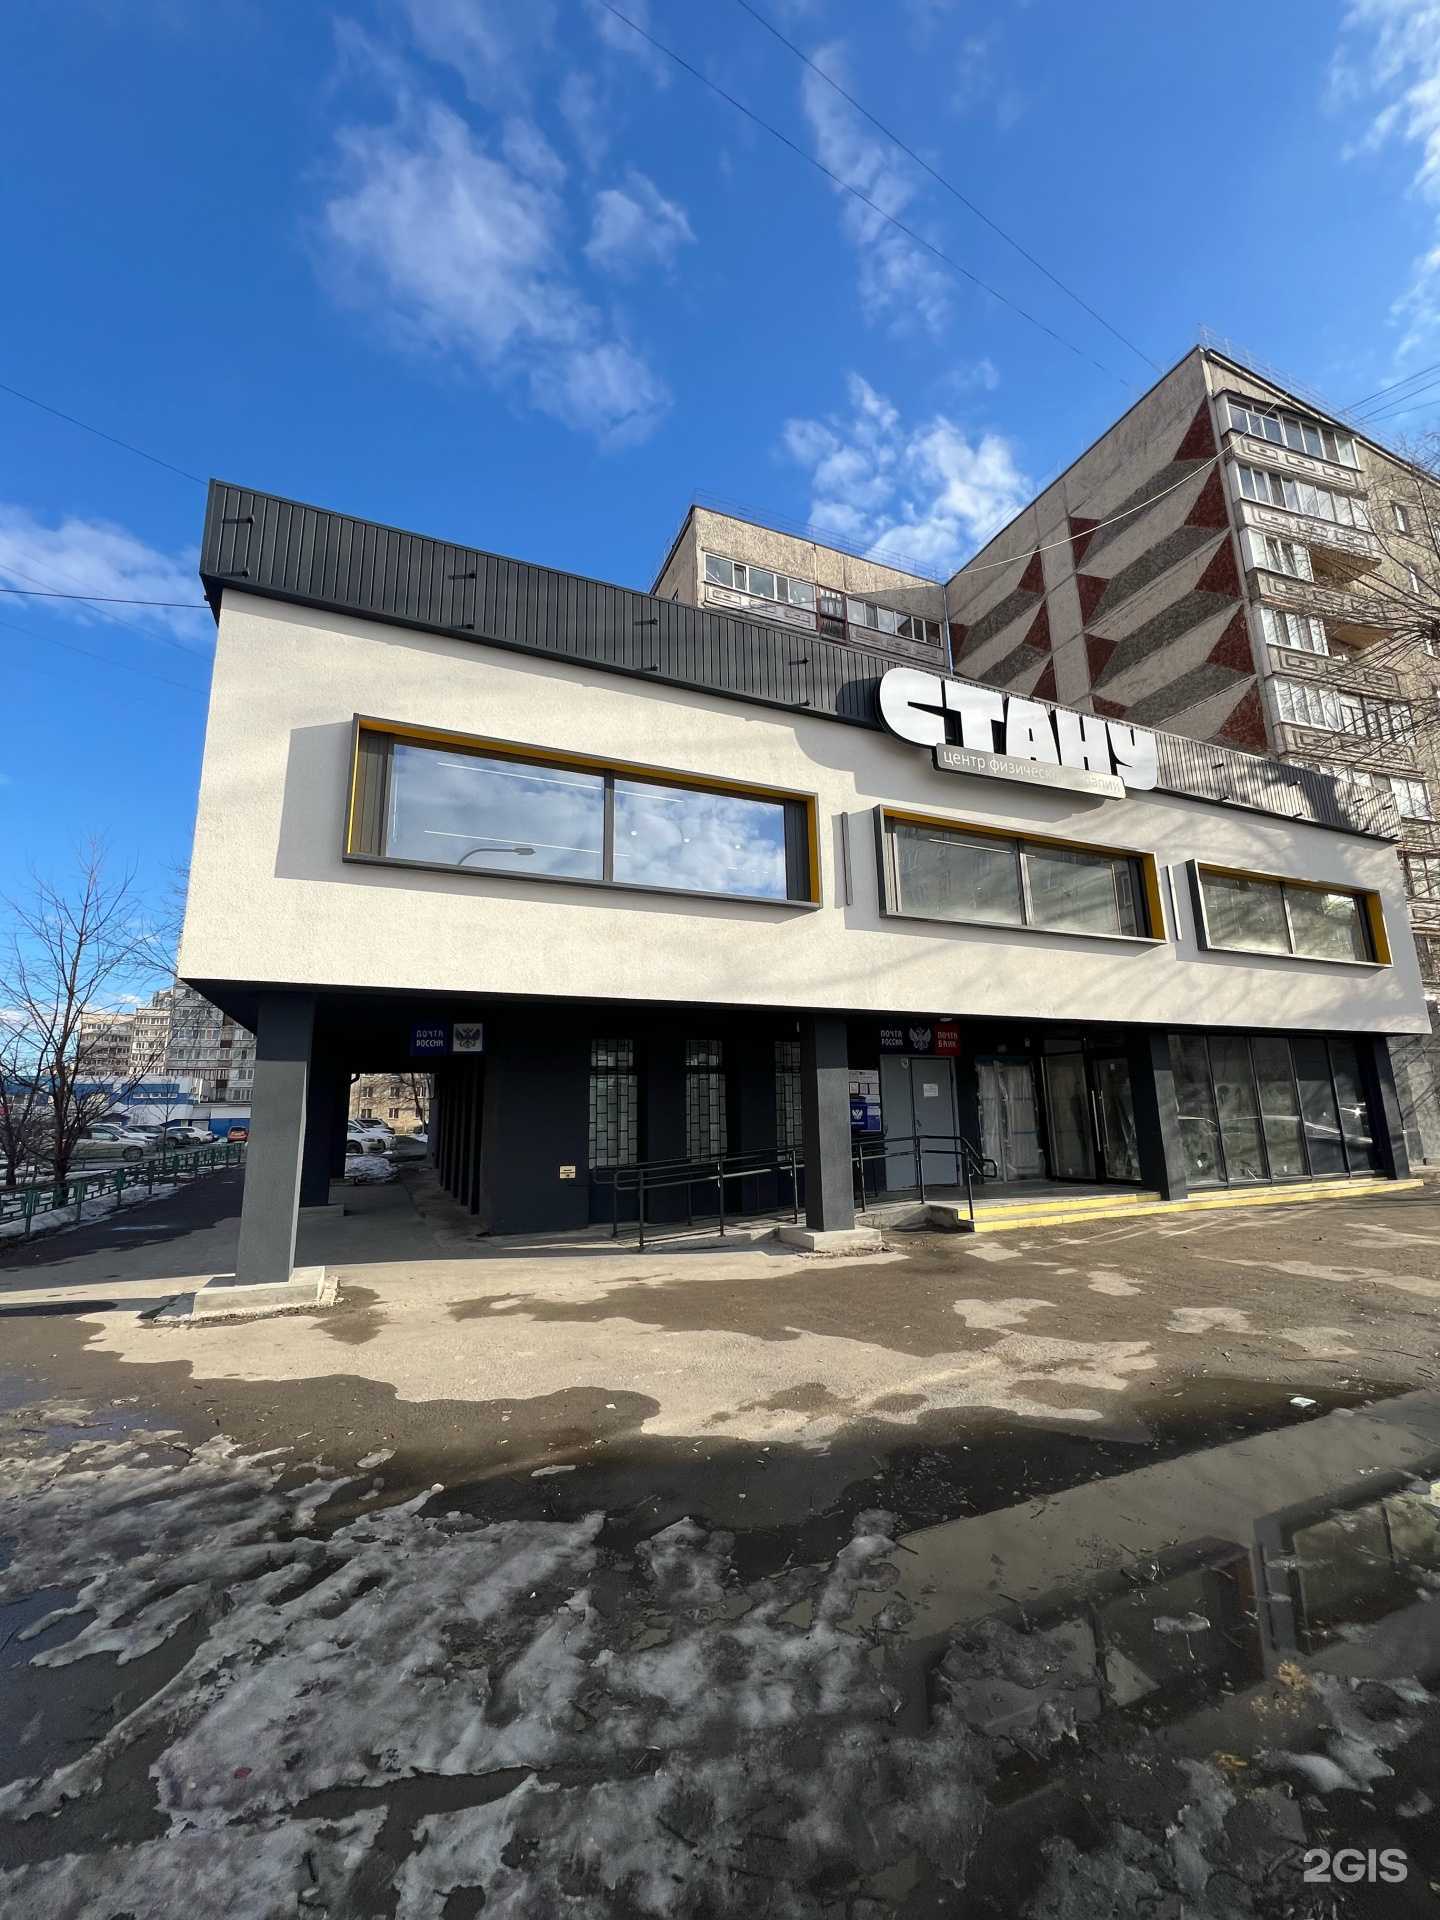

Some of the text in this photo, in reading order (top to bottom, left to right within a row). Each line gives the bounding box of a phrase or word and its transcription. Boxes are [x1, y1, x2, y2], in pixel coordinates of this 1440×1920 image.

[879, 667, 1158, 790] СТАНУ
[943, 751, 986, 771] центр
[416, 1030, 444, 1038] ПОЧТА
[880, 1030, 903, 1038] ПОЧТА
[416, 1039, 444, 1047] РОССИИ
[881, 1039, 904, 1047] РОССИИ
